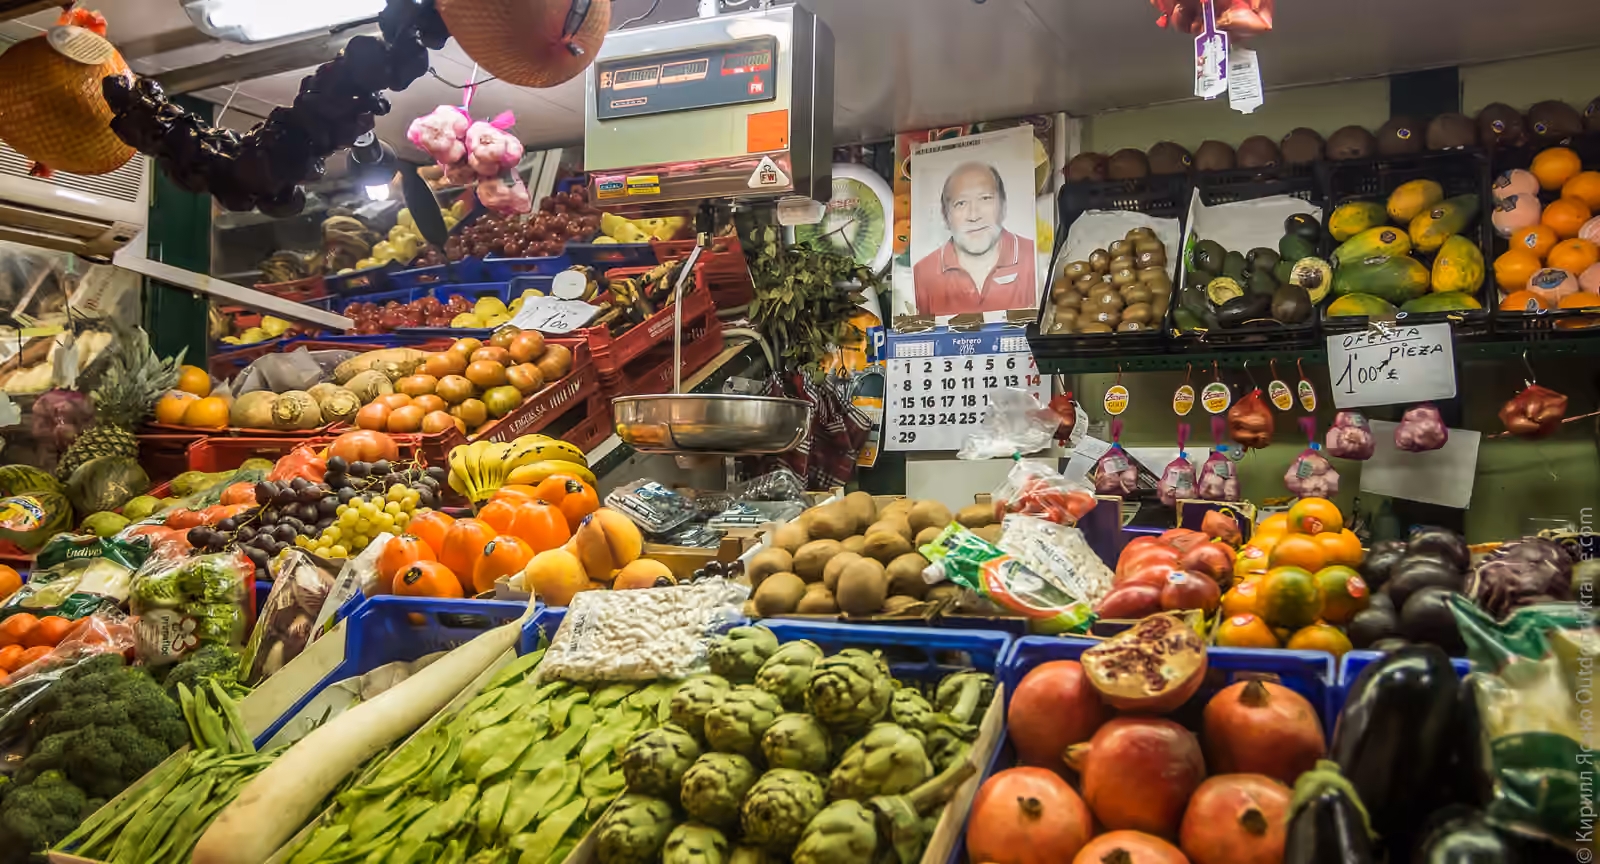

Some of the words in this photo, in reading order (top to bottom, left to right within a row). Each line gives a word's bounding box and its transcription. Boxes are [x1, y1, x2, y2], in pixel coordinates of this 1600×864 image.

[762, 172, 775, 182] FW
[952, 337, 982, 346] Febrero
[1342, 327, 1420, 348] OFERTA
[904, 362, 911, 374] 1
[923, 361, 933, 373] 2
[943, 360, 953, 373] 3
[964, 359, 974, 371] 4
[985, 358, 994, 370] 5
[1006, 357, 1016, 369] 6
[903, 379, 912, 391] 8
[923, 378, 932, 390] 9
[941, 377, 956, 390] 10
[961, 376, 975, 389] 11
[982, 375, 998, 388] 12
[1003, 374, 1019, 387] 13
[1024, 374, 1041, 387] 14
[900, 396, 915, 409] 15
[920, 395, 936, 409] 16
[940, 394, 955, 408] 17
[961, 394, 976, 407] 18
[898, 413, 916, 426] 22
[918, 412, 936, 426] 23
[938, 412, 956, 425] 24
[958, 411, 977, 425] 25
[898, 431, 916, 443] 29
[66, 546, 103, 558] Endives
